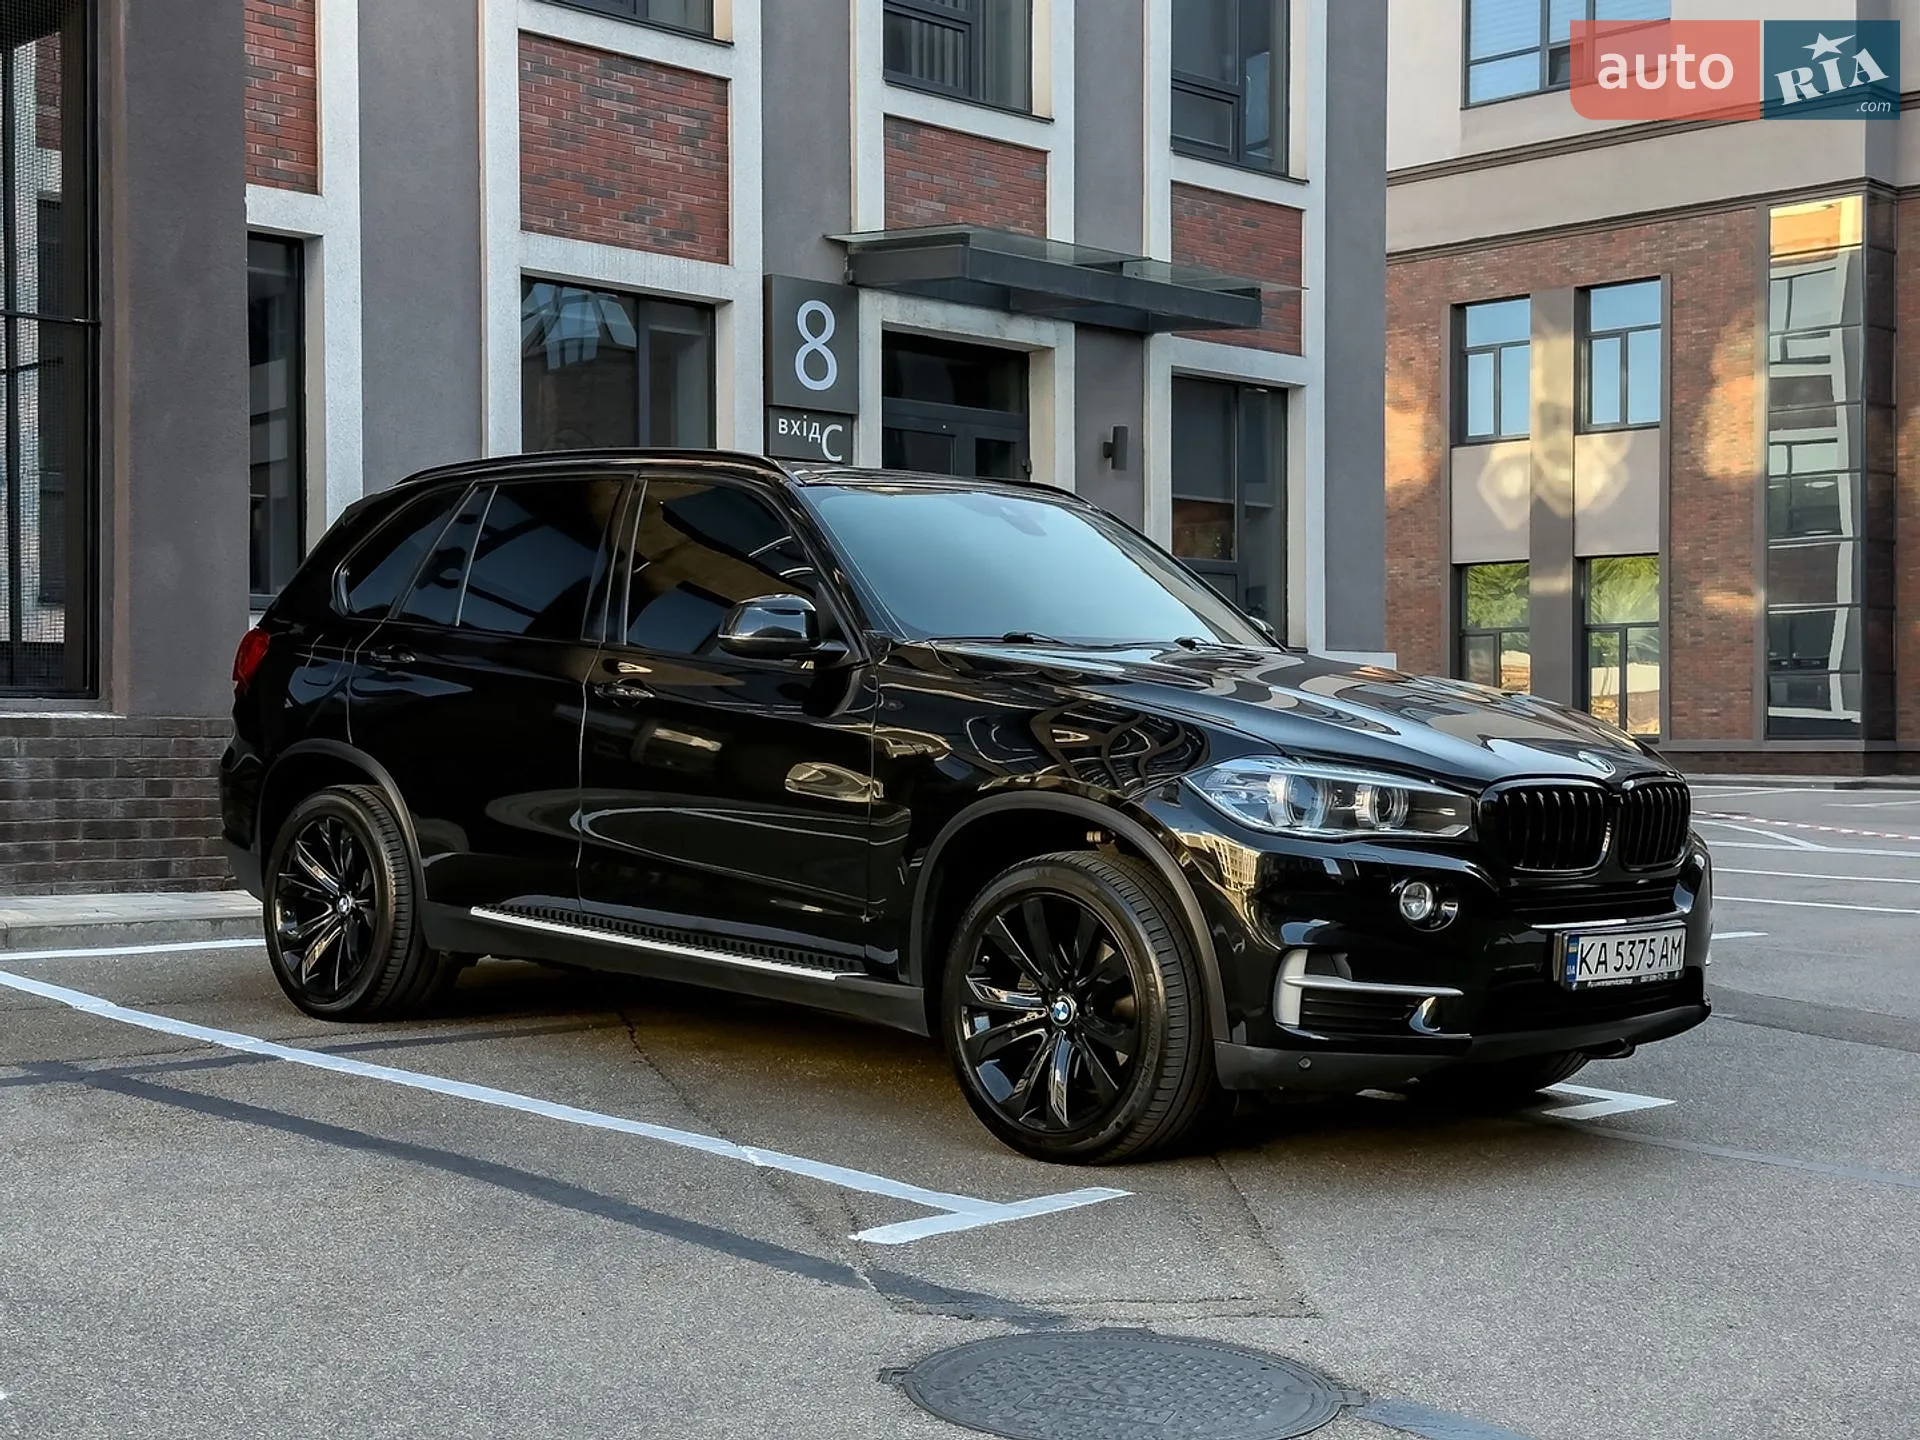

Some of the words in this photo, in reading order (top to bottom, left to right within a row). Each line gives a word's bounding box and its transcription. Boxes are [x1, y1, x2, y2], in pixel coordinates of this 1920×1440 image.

[794, 299, 838, 391] 8
[778, 415, 822, 443] вхід
[1578, 942, 1608, 976] KA
[1613, 937, 1656, 972] 5375
[1658, 935, 1683, 968] AM
